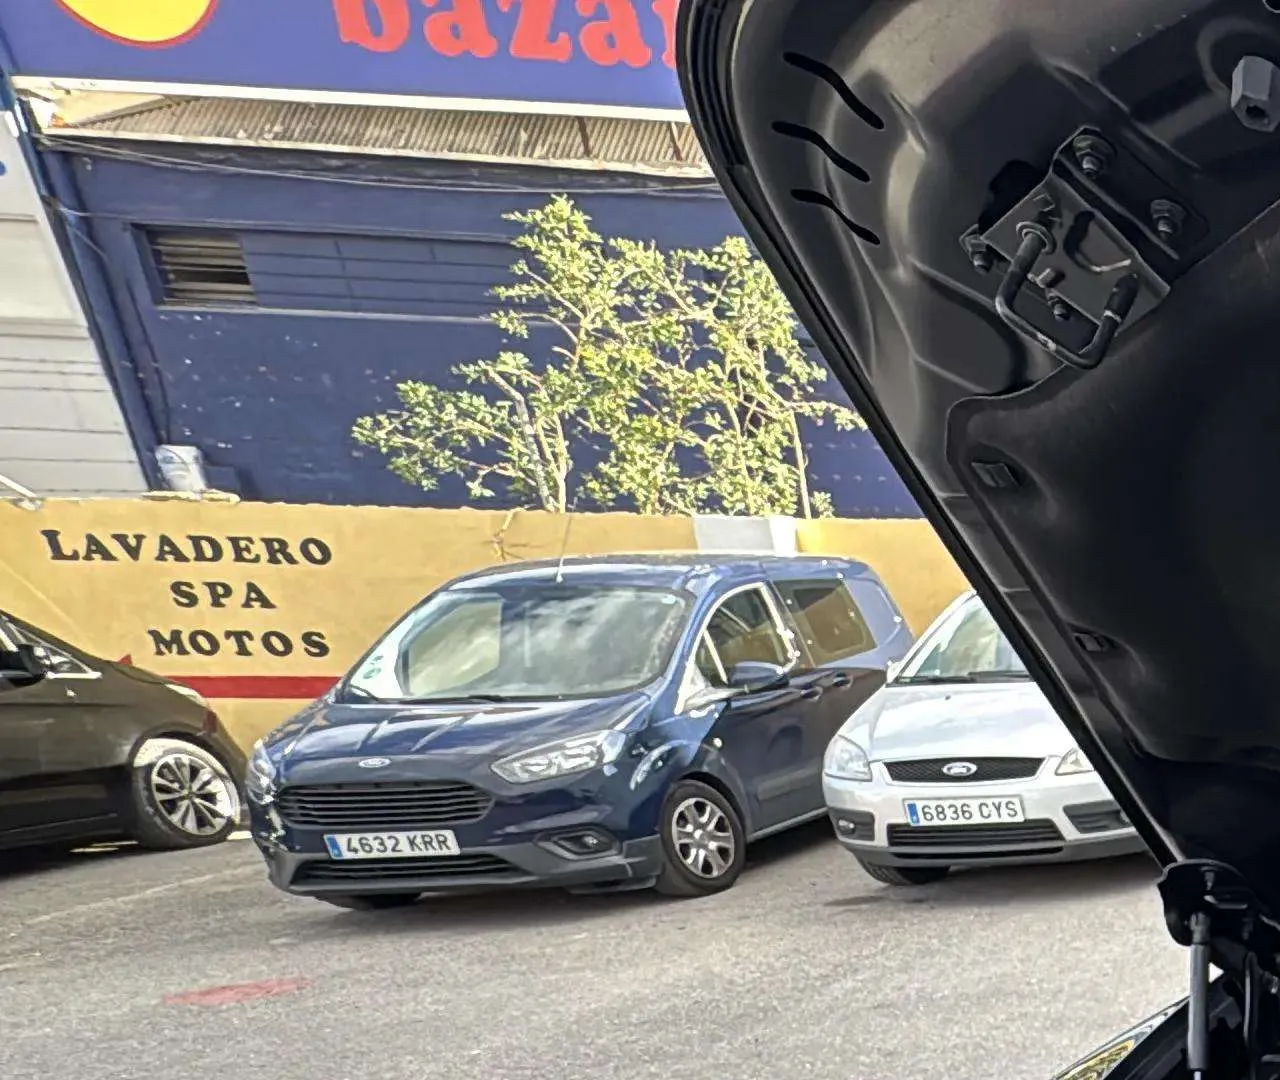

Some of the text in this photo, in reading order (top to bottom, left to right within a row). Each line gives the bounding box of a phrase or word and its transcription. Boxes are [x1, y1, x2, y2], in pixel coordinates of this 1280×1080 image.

[40, 529, 333, 566] LAVADERO
[170, 581, 277, 609] SPA
[147, 629, 331, 658] MOTOS
[921, 800, 1018, 822] 6836 CYS
[346, 833, 451, 855] 4632 KRR
